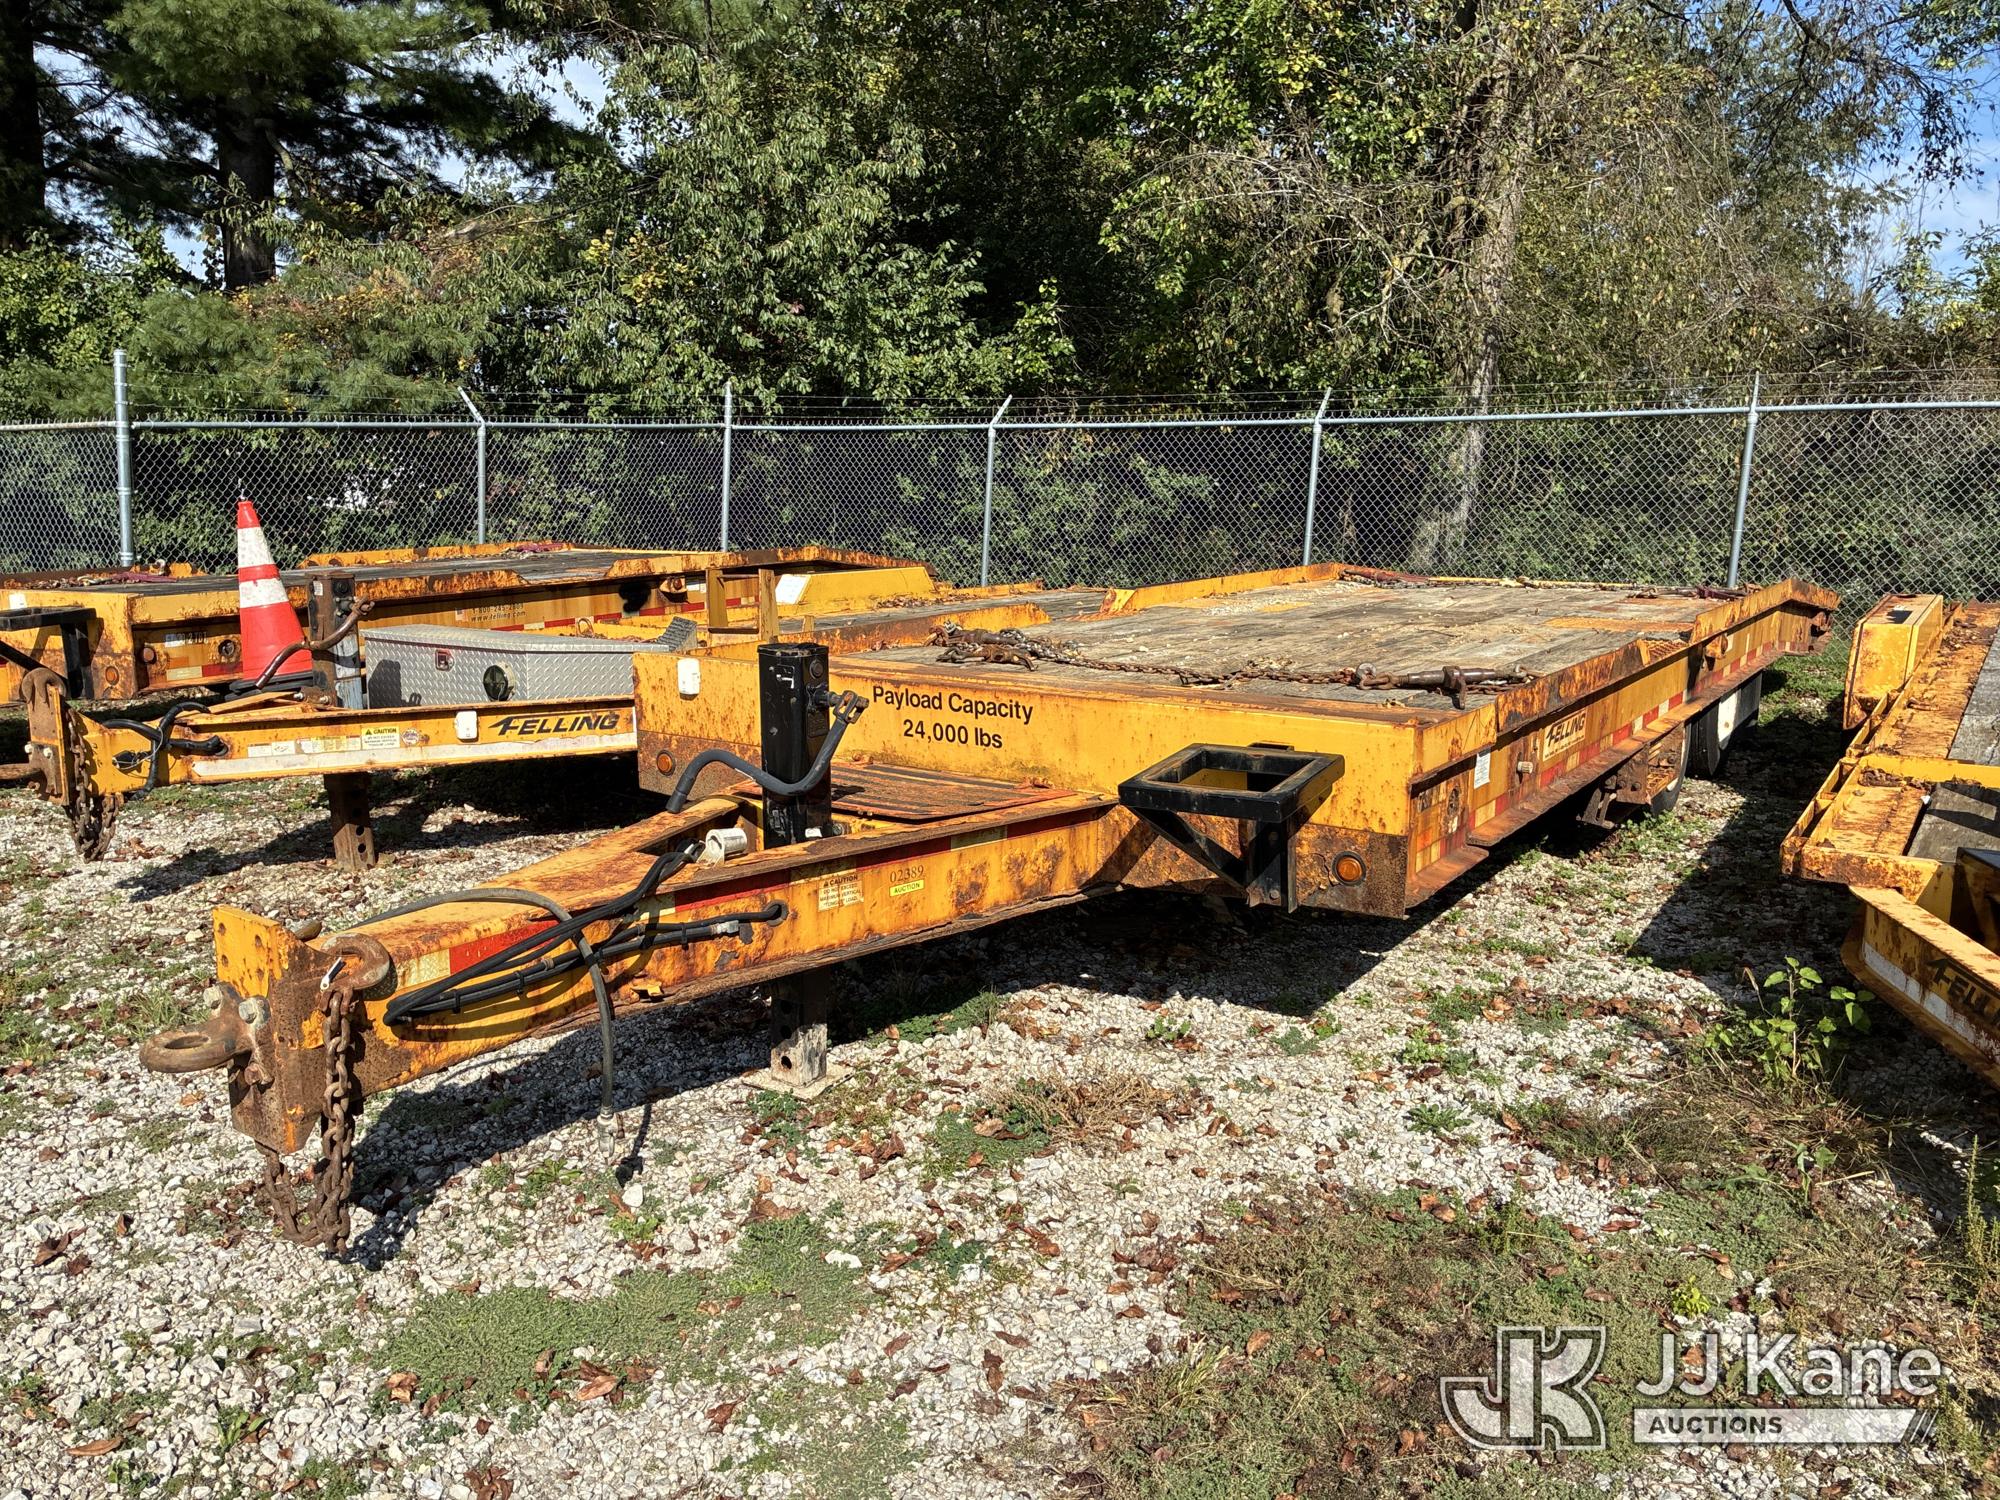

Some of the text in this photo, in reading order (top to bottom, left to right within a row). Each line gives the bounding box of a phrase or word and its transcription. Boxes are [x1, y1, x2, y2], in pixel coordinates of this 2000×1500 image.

[872, 685, 1034, 725] Payload Capacity
[373, 727, 397, 735] CAUTION
[488, 713, 620, 736] FELLING
[903, 719, 1003, 749] 24,000 lbs
[1545, 711, 1587, 748] FELLING
[829, 874, 858, 886] CAUTION
[889, 864, 924, 883] 02389
[893, 882, 920, 894] AUCTION
